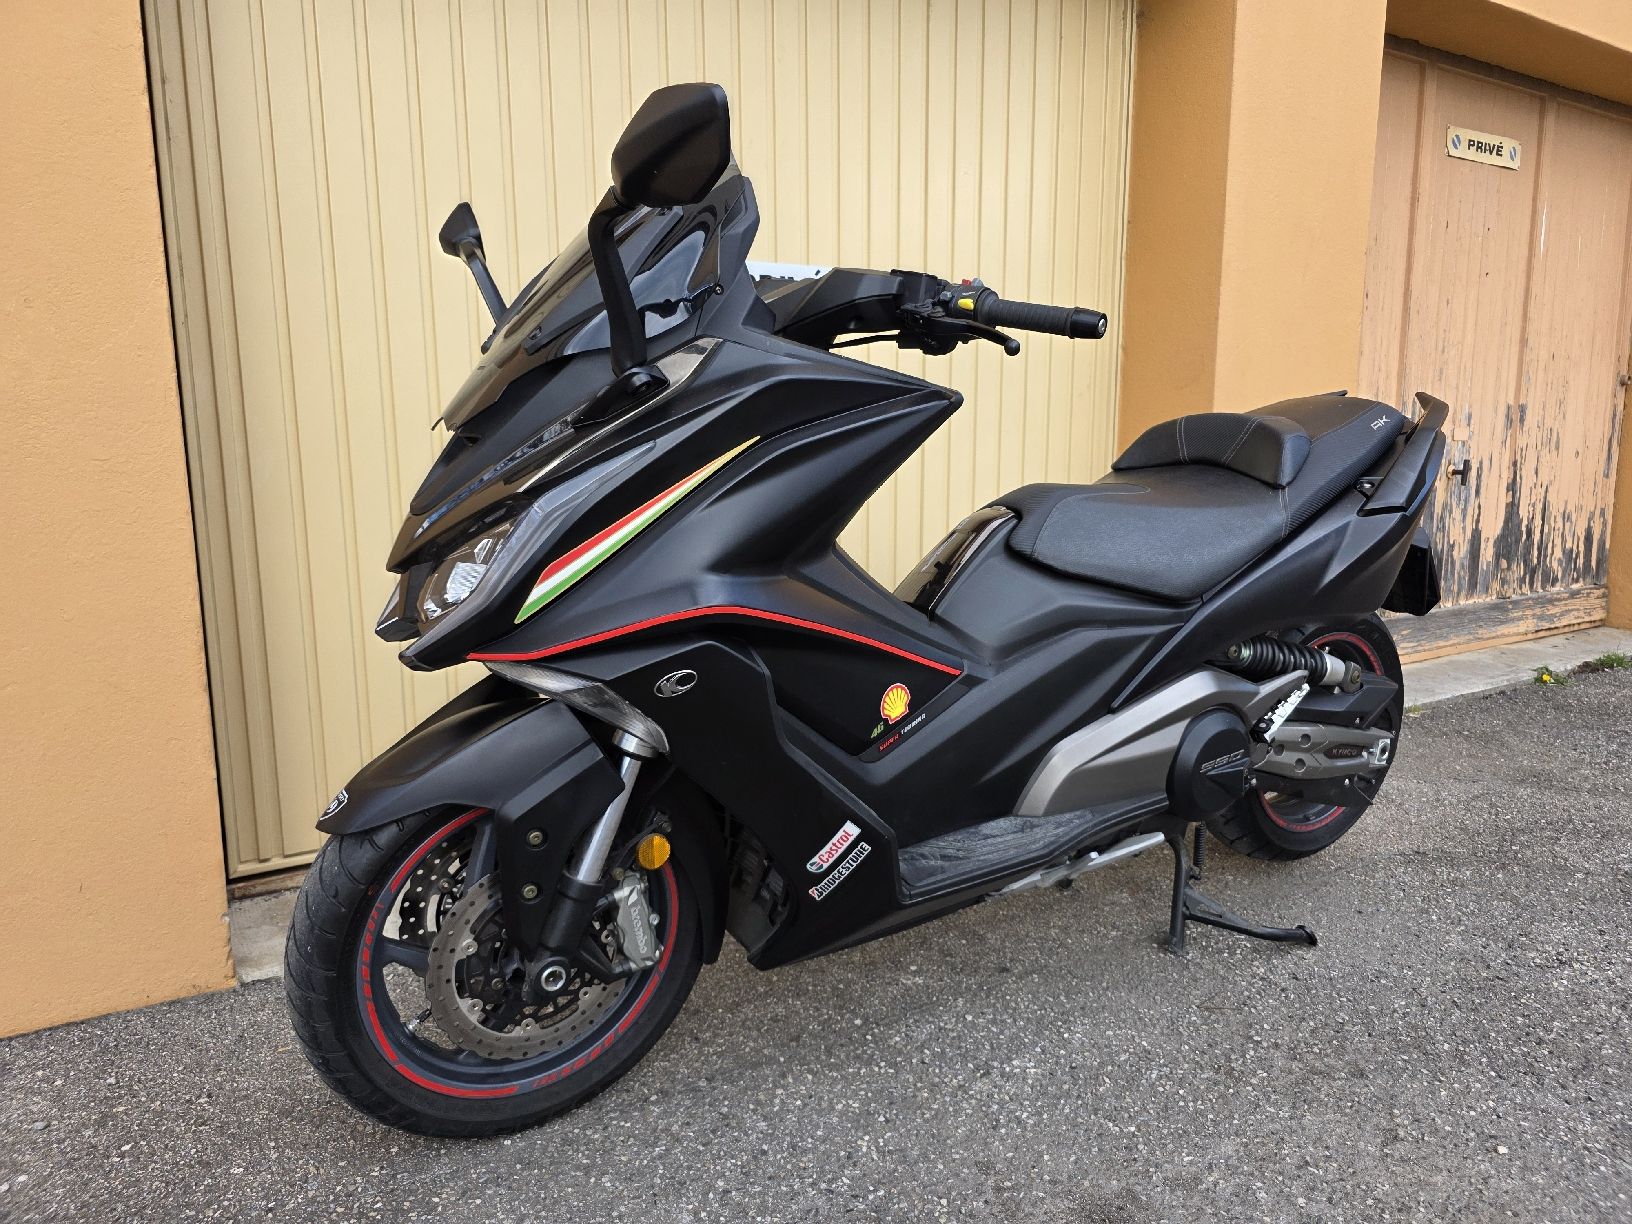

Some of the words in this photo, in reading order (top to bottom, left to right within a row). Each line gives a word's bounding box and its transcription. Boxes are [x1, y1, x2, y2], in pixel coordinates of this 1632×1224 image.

[1467, 138, 1504, 157] PRIVÉ
[818, 829, 854, 864] Castrol
[811, 843, 871, 899] BRIDGESTONE
[631, 904, 648, 954] brembo
